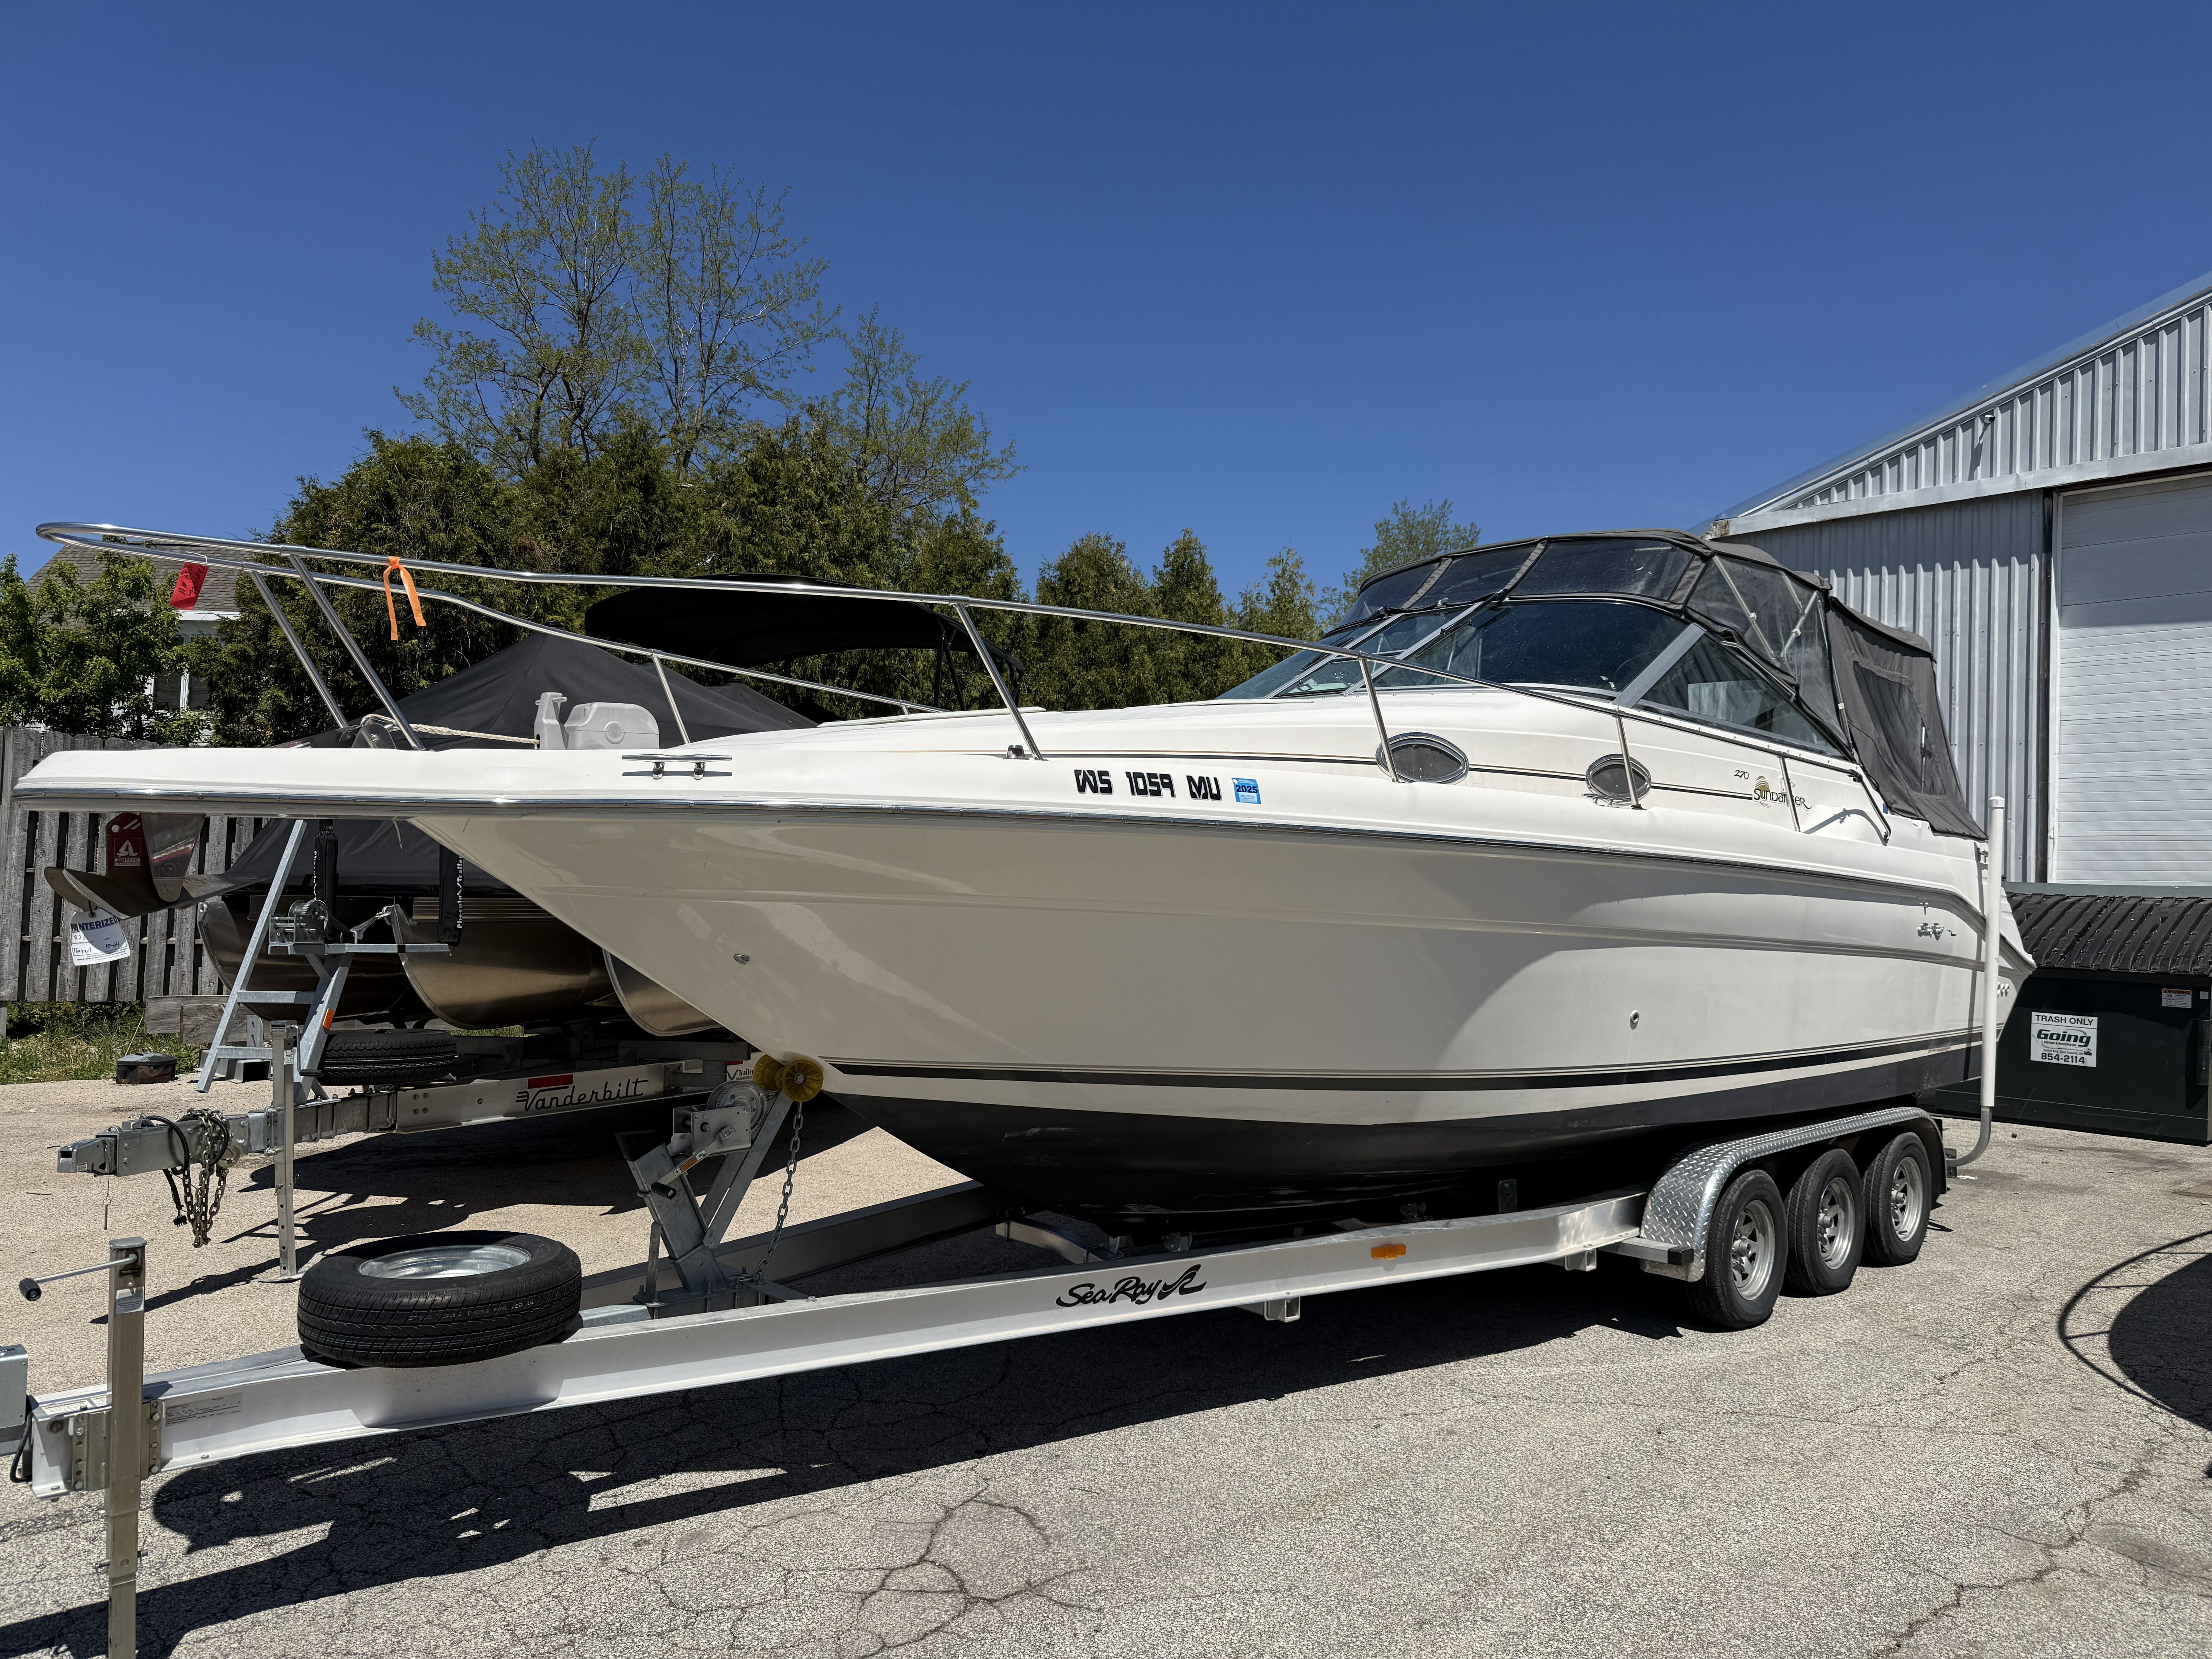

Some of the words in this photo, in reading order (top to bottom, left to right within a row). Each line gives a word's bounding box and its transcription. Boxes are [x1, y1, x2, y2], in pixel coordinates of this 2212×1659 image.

[1734, 769, 1749, 780] 270
[1074, 769, 1113, 795] WS
[1125, 771, 1176, 798] 1059
[1186, 775, 1222, 801] MU
[1235, 785, 1258, 793] 2025
[2035, 1015, 2066, 1024] TRASH
[2069, 1017, 2094, 1025] ONLY
[2037, 1029, 2092, 1047] Going
[2041, 1053, 2085, 1064] 854-2114
[515, 1078, 649, 1111] Vanderbilt
[1056, 1283, 1112, 1307] Sea
[1109, 1276, 1162, 1305] Ray
